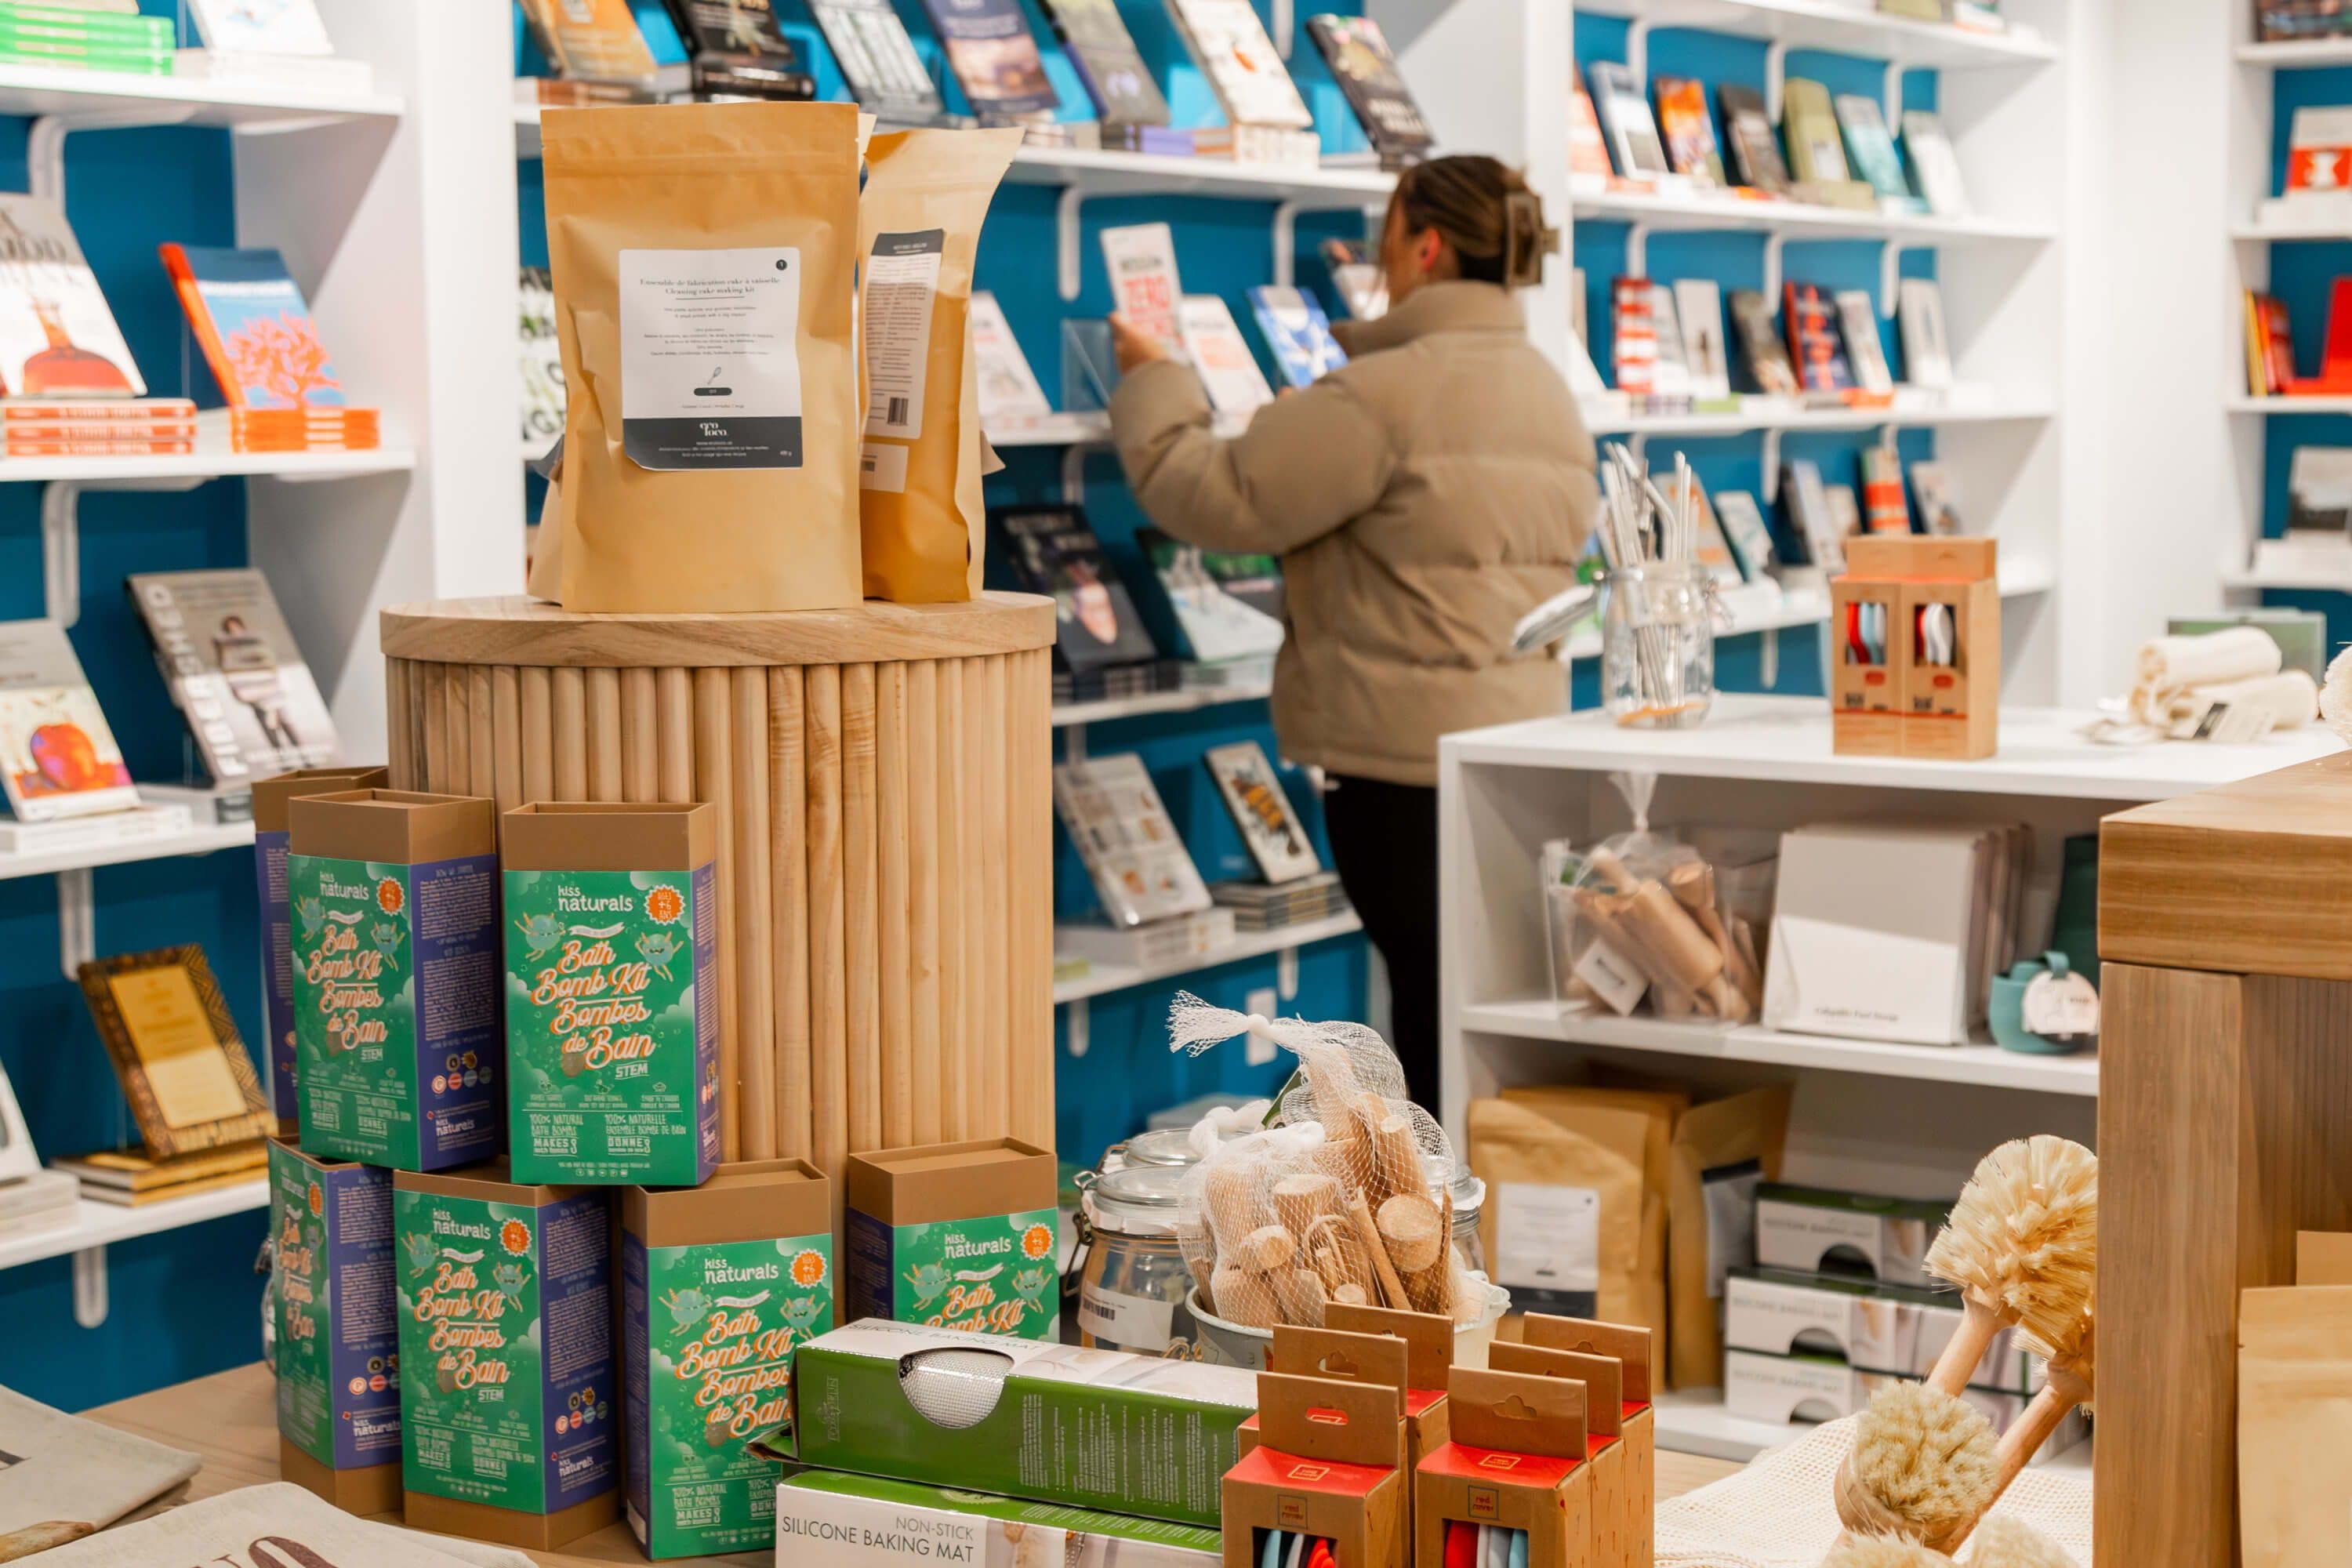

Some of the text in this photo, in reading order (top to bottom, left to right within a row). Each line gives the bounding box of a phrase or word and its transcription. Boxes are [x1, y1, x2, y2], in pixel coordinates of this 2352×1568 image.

[666, 287, 697, 296] Cleaning
[717, 286, 742, 295] making
[320, 880, 369, 901] naturals
[557, 884, 581, 897] kiss
[558, 895, 634, 913] naturals
[321, 924, 360, 956] Bath
[307, 949, 383, 985] Bomb Kit
[557, 939, 615, 975] Bath
[531, 962, 652, 1007] Bomb Kit
[319, 979, 383, 1014] Bombes
[550, 997, 652, 1036] Bombes
[341, 1009, 388, 1050] Bain
[562, 1025, 655, 1069] de Bain
[615, 1062, 649, 1078] STEM
[436, 1119, 475, 1138] naturals
[554, 1114, 583, 1125] NATURAL
[629, 1114, 666, 1124] NATURELLE
[533, 1138, 569, 1147] MAKES
[608, 1138, 644, 1147] DONNE
[433, 1208, 451, 1222] kiss
[434, 1218, 492, 1240] naturals
[945, 1233, 965, 1245] kiss
[945, 1236, 1012, 1259] naturals
[704, 1258, 728, 1269] kiss
[705, 1262, 779, 1284] naturals
[434, 1261, 479, 1295] Bath
[414, 1287, 506, 1323] Bomb Kit
[942, 1282, 996, 1319] Bath
[703, 1308, 761, 1346] Bath
[988, 1298, 1026, 1334] Kit
[428, 1320, 506, 1352] Bombes
[930, 1334, 1000, 1345] BAKING
[1004, 1341, 1046, 1350] MAT
[675, 1326, 797, 1380] Bomb Kit
[437, 1348, 510, 1390] de Bain
[478, 1388, 505, 1403] STEM
[695, 1367, 790, 1407] Bombes
[706, 1403, 732, 1425] de
[560, 1455, 594, 1478] naturals
[677, 1508, 712, 1519] MAKES
[1284, 1504, 1300, 1513] red
[1472, 1504, 1494, 1512] rover
[896, 1515, 975, 1541] NON-STICK
[782, 1516, 975, 1563] SILICONE BAKING MAT
